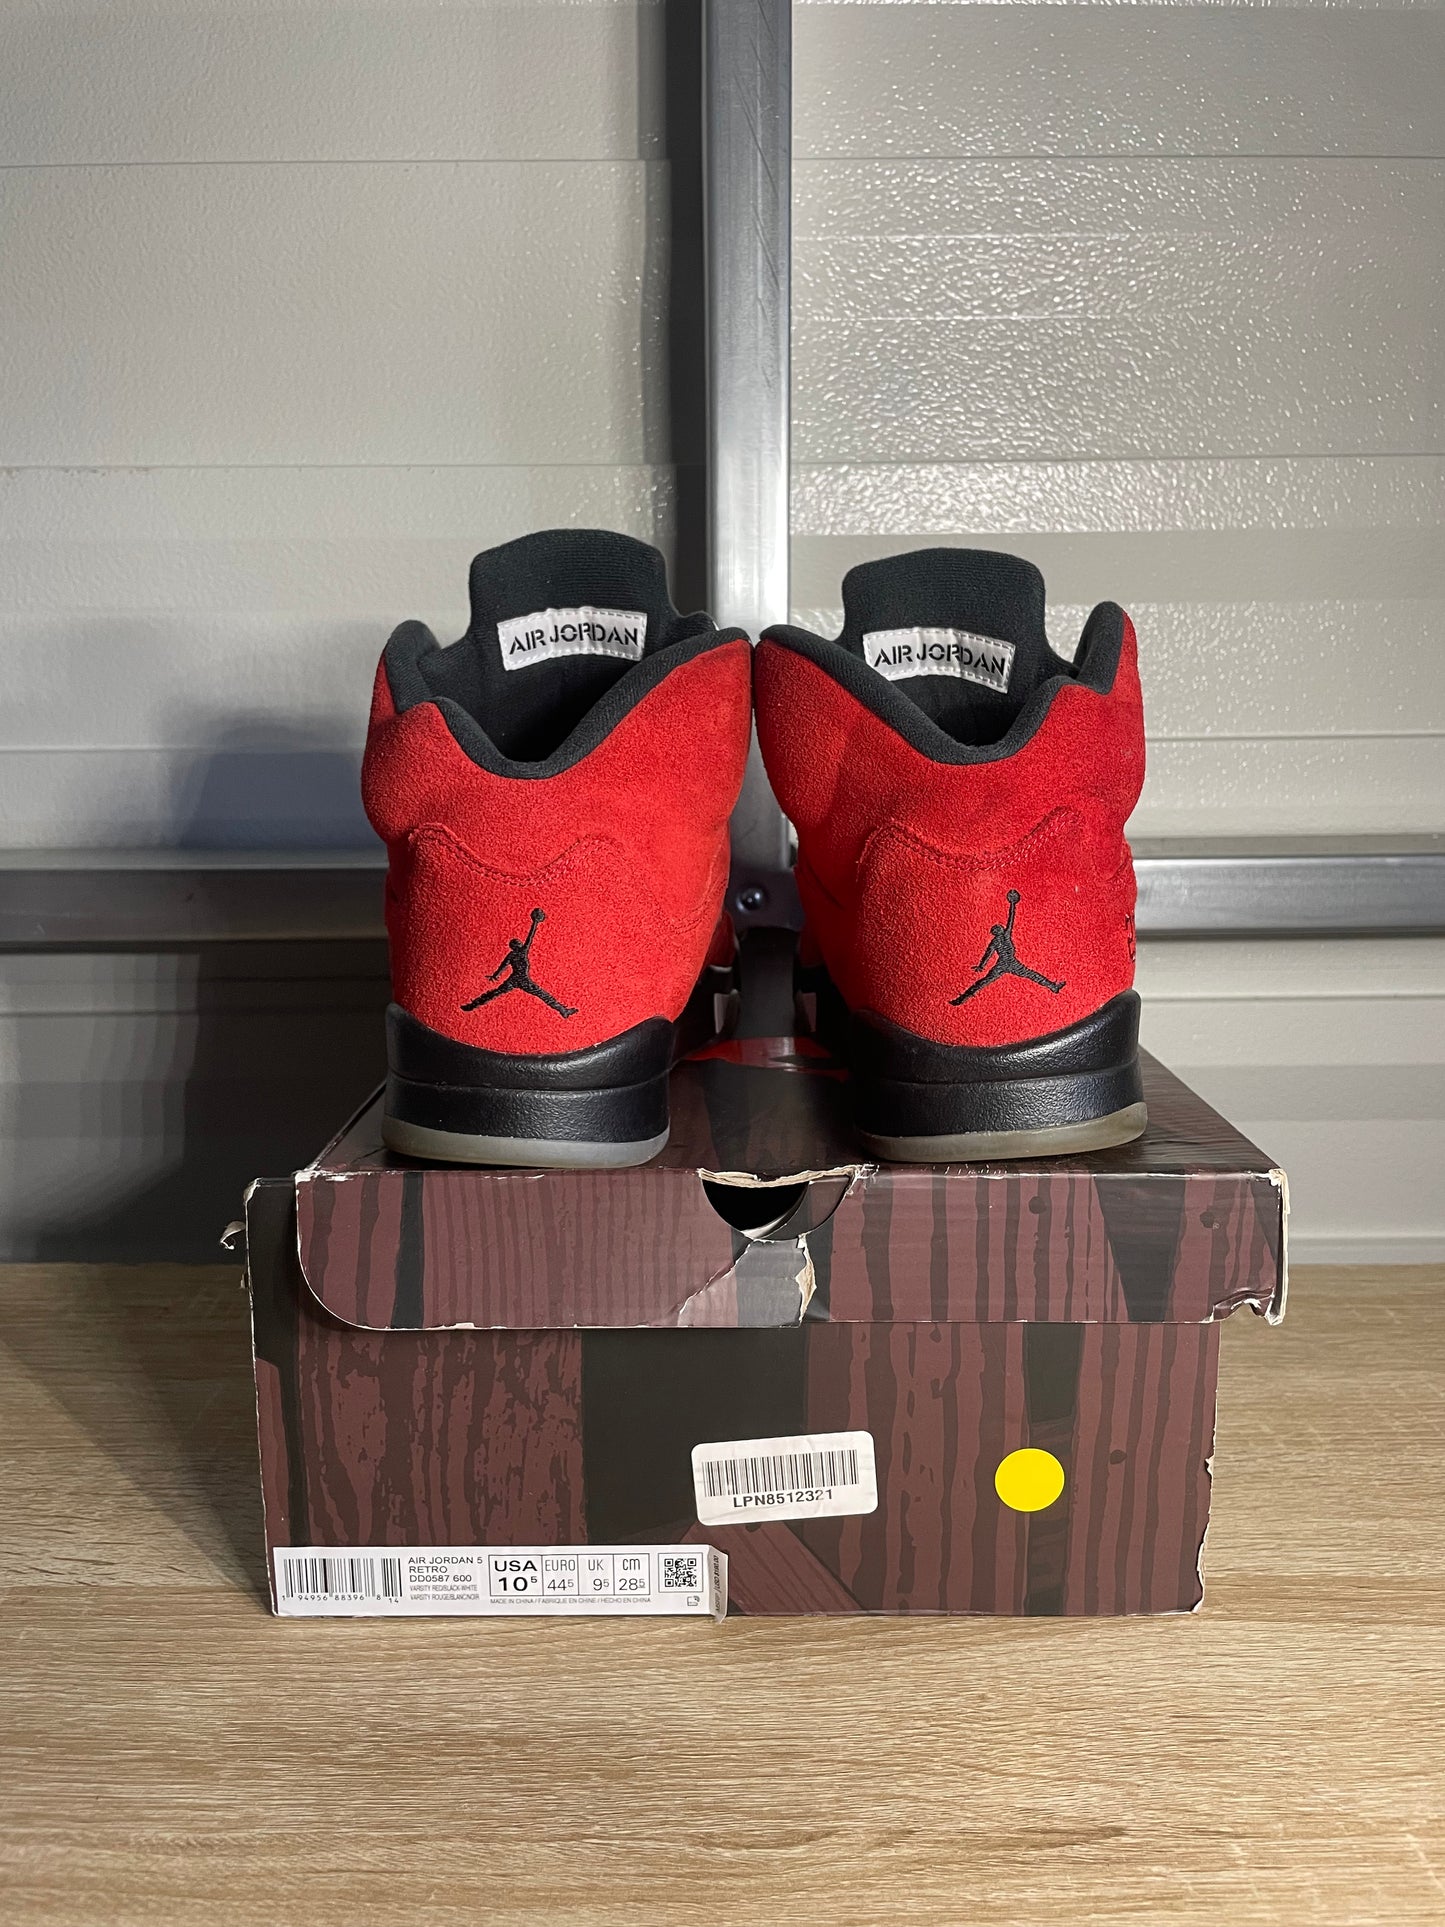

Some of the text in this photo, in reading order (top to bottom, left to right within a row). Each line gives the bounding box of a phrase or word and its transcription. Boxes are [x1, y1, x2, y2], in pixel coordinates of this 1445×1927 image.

[509, 622, 639, 655] AIR JORDAN
[873, 643, 1006, 677] AIR JORDAN
[733, 1488, 833, 1508] LPN8512321
[408, 1556, 483, 1564] AIR JORDAN 5
[494, 1559, 538, 1572] USA
[545, 1559, 576, 1571] EURO
[588, 1559, 604, 1571] UK
[409, 1565, 448, 1573] RETRO
[409, 1574, 472, 1582] DD0587 600
